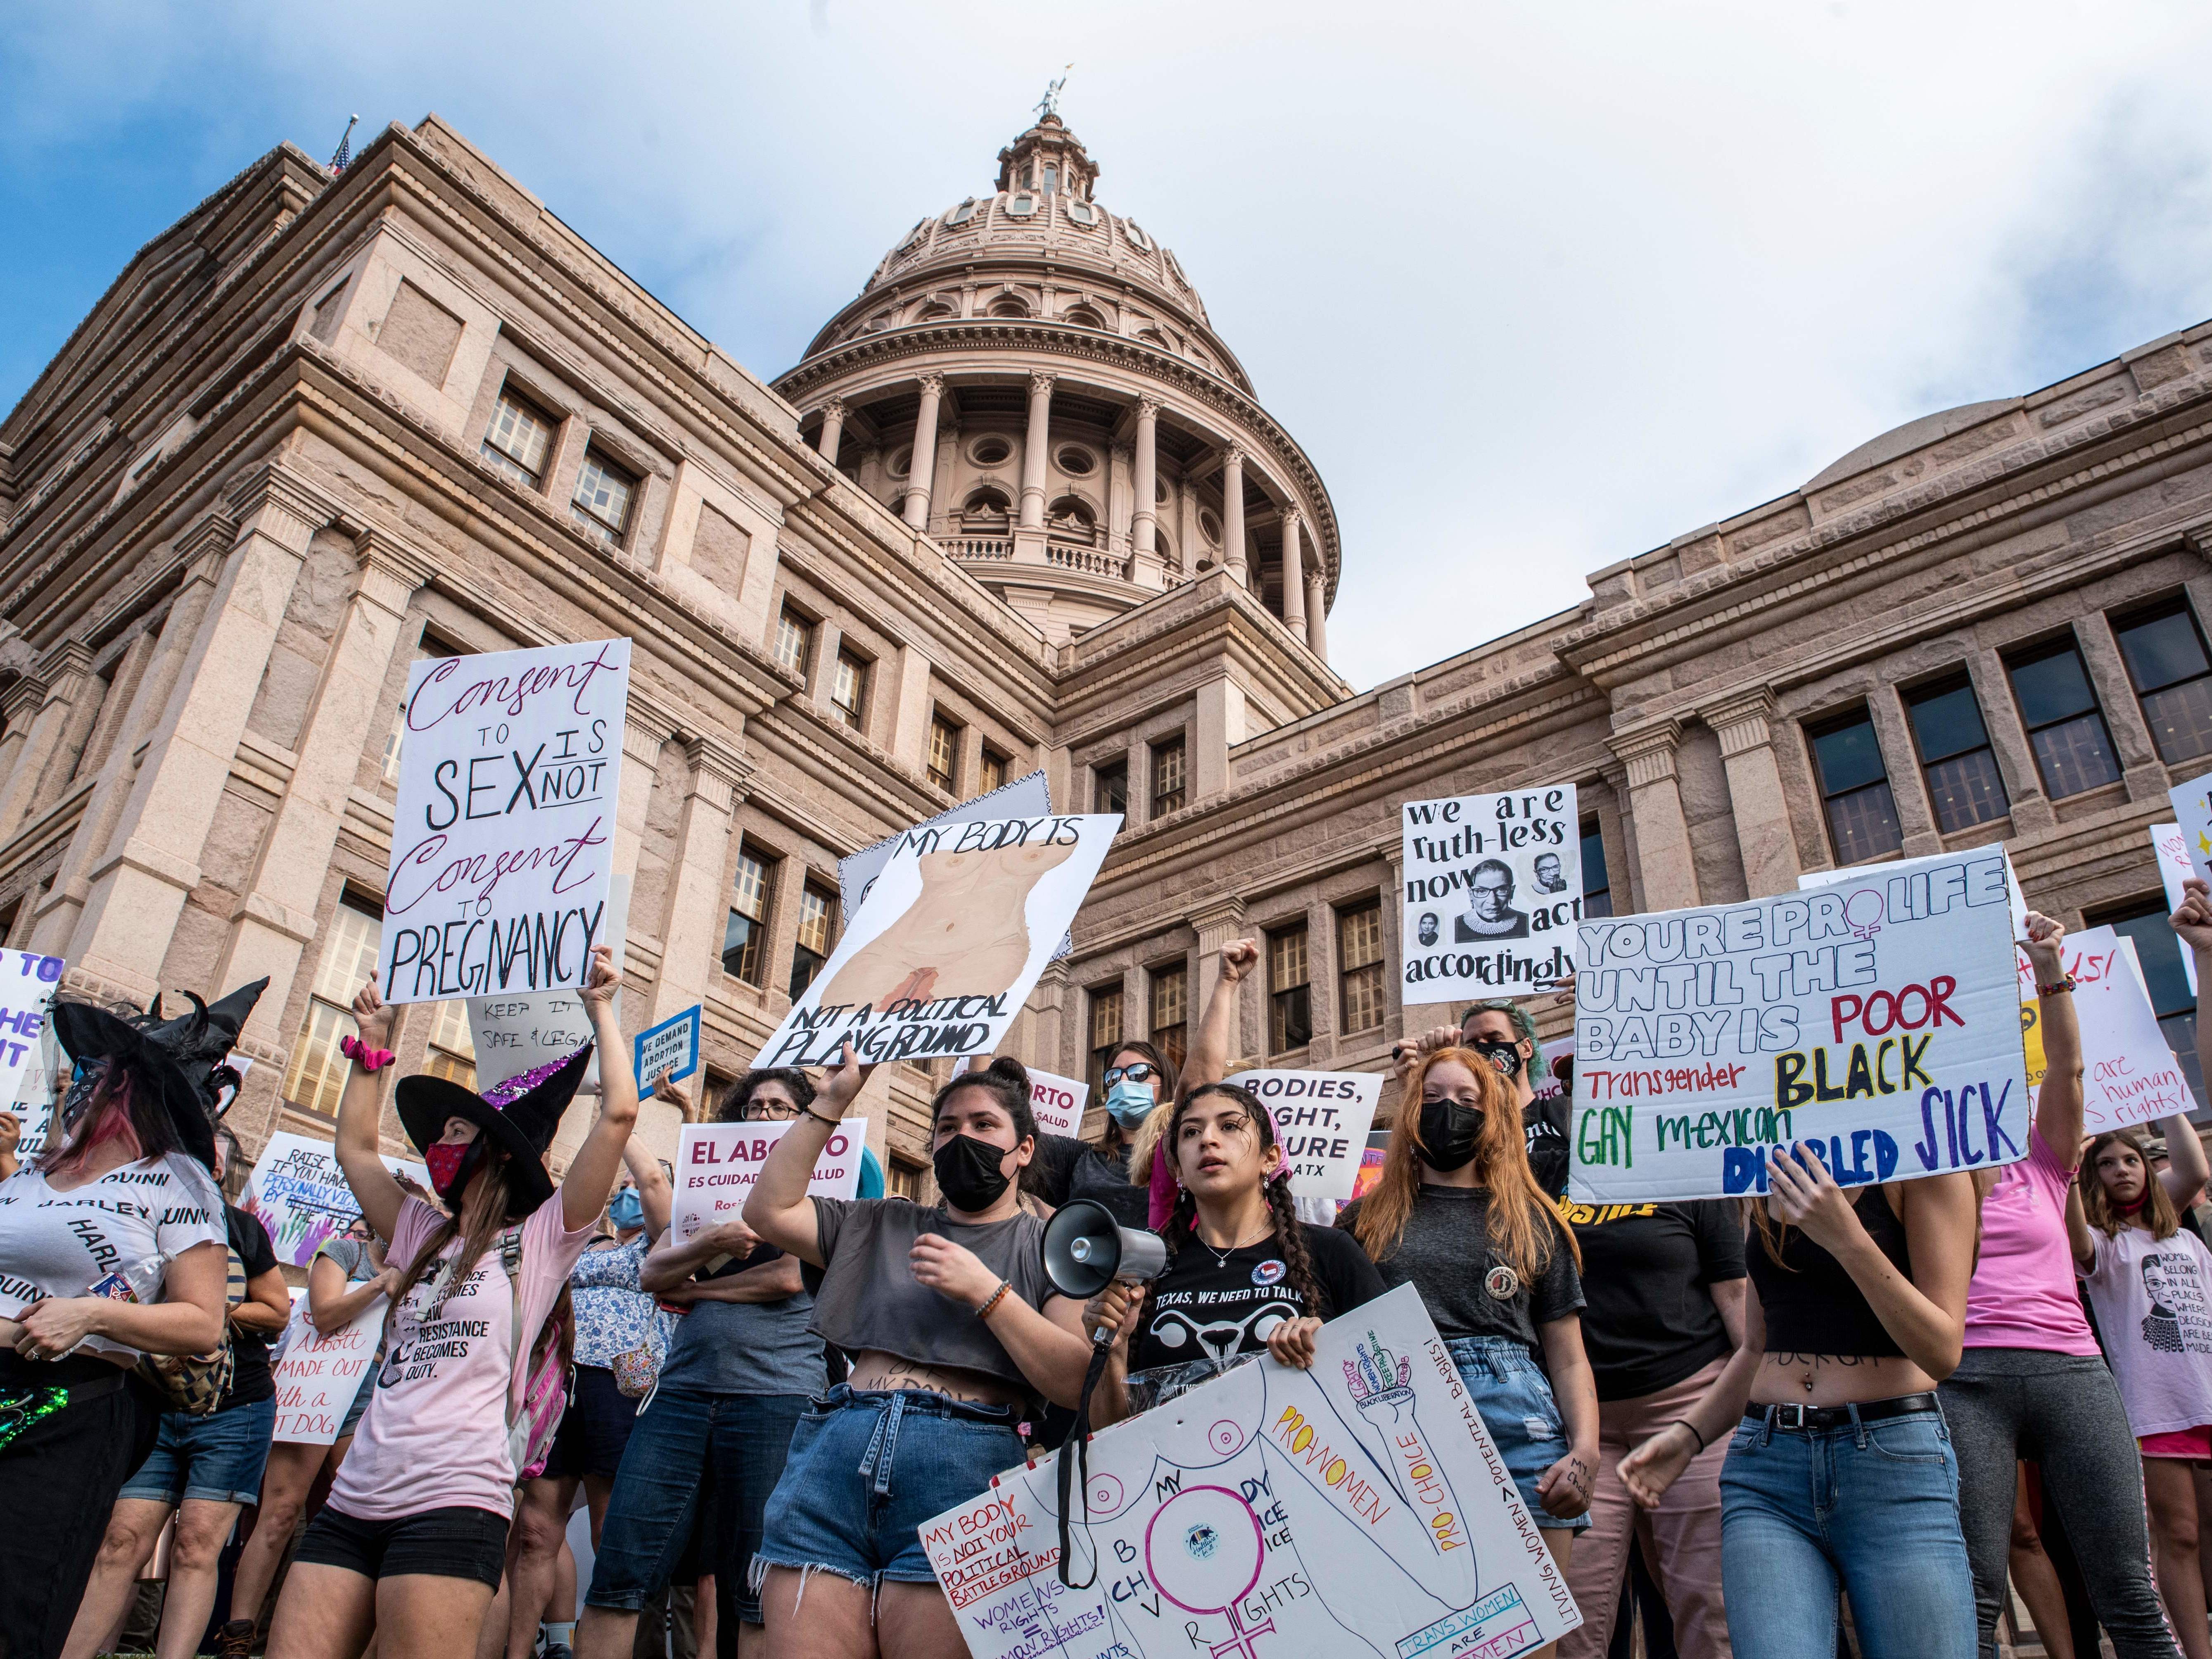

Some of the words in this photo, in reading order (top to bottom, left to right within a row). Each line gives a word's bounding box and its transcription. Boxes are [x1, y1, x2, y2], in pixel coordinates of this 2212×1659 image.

[408, 643, 618, 731] Consent
[478, 723, 509, 746] TO
[552, 719, 607, 759] IS
[426, 743, 546, 831] SEX
[542, 763, 606, 802] NOT
[1407, 801, 1460, 825] we
[1495, 790, 1563, 820] are
[892, 825, 954, 860] MY
[953, 818, 1044, 853] BODY
[1042, 817, 1084, 846] IS
[1412, 818, 1566, 863] ruth-less
[385, 816, 607, 915] Consent
[1407, 868, 1476, 903] now
[458, 896, 492, 917] TO
[1531, 897, 1582, 932] act
[1577, 908, 1762, 966] YOURE
[385, 901, 604, 1000] PREGNANCY
[21, 953, 65, 982] TO
[1577, 960, 1743, 1012] UNTIL
[1751, 939, 1876, 1001] THE
[485, 1002, 529, 1021] KEEP
[788, 1003, 856, 1030] NOT
[847, 1002, 873, 1027] A
[879, 992, 1008, 1022] POLITICAL
[1577, 1009, 1731, 1061] BABY
[1739, 1005, 1799, 1053] IS
[1832, 974, 1965, 1044] POOR
[483, 1030, 523, 1048] SAFE
[655, 1023, 688, 1048] DEMAND
[771, 1022, 990, 1069] PLAYGROUND
[644, 1040, 683, 1068] ABORTION
[646, 1057, 679, 1081] JUSTCE
[1775, 1033, 1934, 1110] BLACK
[2094, 1056, 2134, 1081] are
[1244, 1078, 1363, 1103] BODIES,
[2101, 1071, 2178, 1103] human
[2115, 1084, 2188, 1123] rights!
[1035, 1111, 1068, 1128] SALUD
[1267, 1106, 1341, 1131] GHT,
[1578, 1105, 1633, 1169] GAY
[1915, 1079, 2018, 1171] SICK
[289, 1149, 330, 1170] RAISE
[691, 1141, 721, 1164] EL
[267, 1159, 292, 1173] IF
[292, 1163, 316, 1181] YOU
[319, 1172, 347, 1189] HAVE
[688, 1177, 704, 1188] ES
[1293, 1164, 1325, 1177] ATX
[263, 1173, 333, 1199] PERSONALLY
[263, 1188, 284, 1203] BY
[288, 1205, 321, 1224] THE
[2160, 1253, 2192, 1262] WOMEN
[2163, 1265, 2197, 1274] BELONG
[1487, 1269, 1503, 1282] WOMEN'S
[1505, 1270, 1516, 1282] MARCH
[2167, 1278, 2178, 1286] IN
[2181, 1278, 2200, 1288] ALL
[1157, 1291, 1192, 1310] TEXAS,
[1198, 1291, 1218, 1304] WE
[1218, 1289, 1250, 1303] NEED
[1254, 1287, 1269, 1297] TO
[1273, 1286, 1303, 1303] TALK
[2171, 1290, 2204, 1302] PLACES
[2174, 1302, 2208, 1315] WHERE
[422, 1305, 442, 1322] AW
[292, 1329, 366, 1353] Abbott
[419, 1321, 490, 1343] RESISTANCE
[2184, 1329, 2200, 1338] ARE
[413, 1341, 469, 1362] BECOMES
[1356, 1343, 1372, 1370] RIGHTS
[276, 1359, 329, 1379] MADE
[332, 1358, 369, 1377] OUT
[406, 1362, 437, 1380] DUTY.
[1365, 1368, 1381, 1394] WOMEN
[1384, 1367, 1396, 1387] FREE
[1423, 1337, 1462, 1400] BABIES!
[311, 1391, 331, 1407] a
[1360, 1398, 1377, 1409] BLACK
[1377, 1389, 1411, 1402] LIBERATION
[291, 1414, 335, 1434] DOG
[1460, 1401, 1506, 1485] POTENTIAL
[1156, 1469, 1182, 1503] MY
[926, 1522, 954, 1551] MY
[959, 1494, 1015, 1535] BODY
[1508, 1503, 1545, 1564] WOMEN
[933, 1553, 951, 1568] IS
[953, 1537, 987, 1563] NOT
[984, 1514, 1033, 1546] YOUR
[941, 1546, 1030, 1590] POLITICAL
[973, 1579, 1065, 1630] WOMENS
[1540, 1564, 1577, 1625] LIVING
[999, 1602, 1058, 1634] RIGHTS
[1040, 1604, 1106, 1641] RIGHTS!
[1400, 1619, 1455, 1655] TRANS
[1458, 1588, 1514, 1627] WOMEN
[1452, 1627, 1485, 1654] ARE
